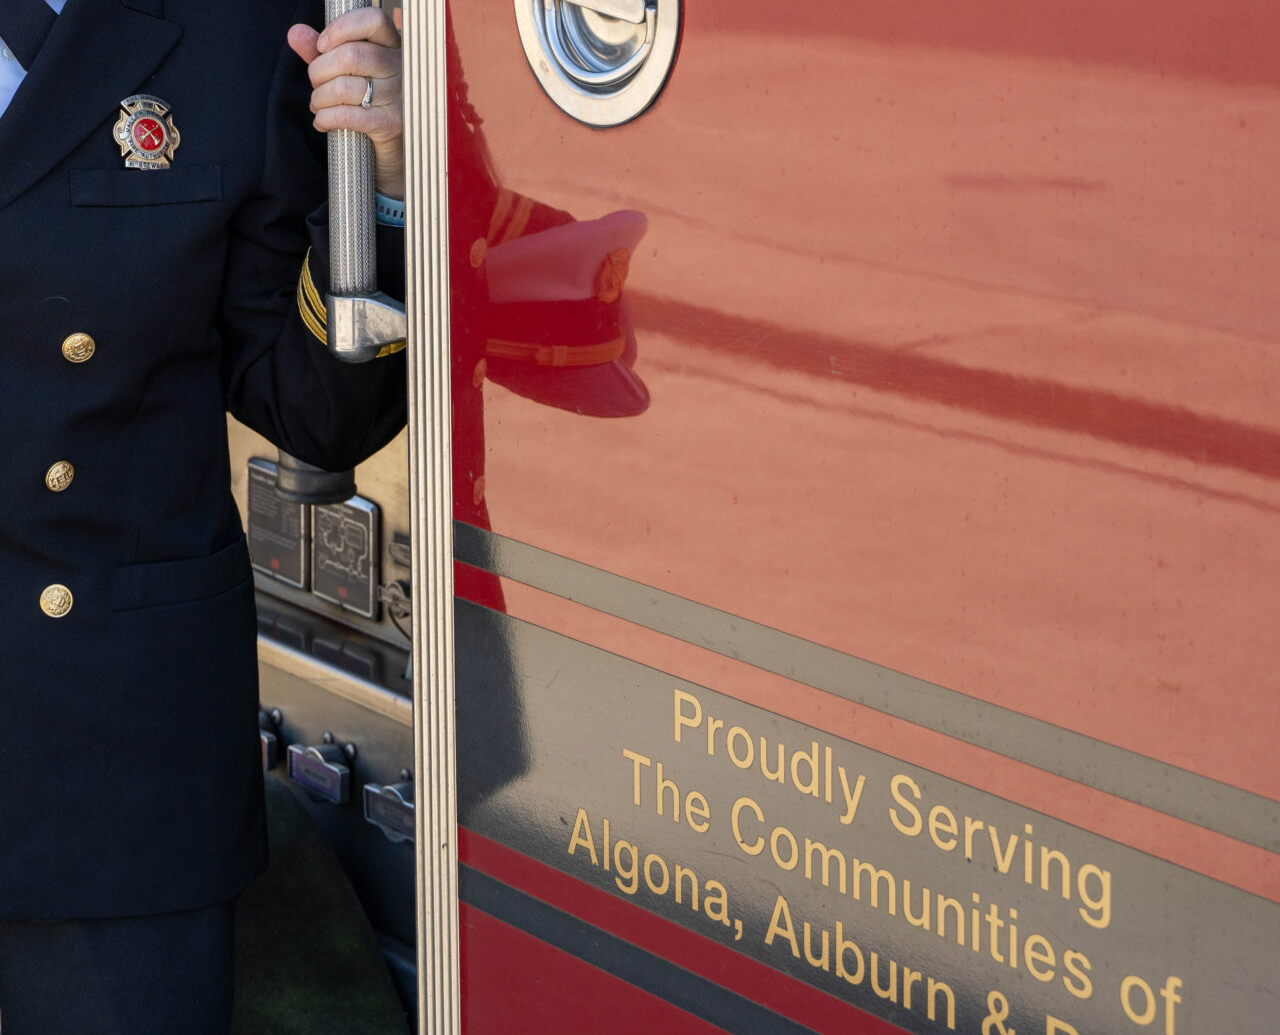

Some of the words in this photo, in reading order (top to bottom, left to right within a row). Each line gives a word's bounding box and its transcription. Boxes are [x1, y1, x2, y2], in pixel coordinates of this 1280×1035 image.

[567, 807, 743, 942] Algona,
[764, 894, 955, 1030] Auburn
[981, 989, 1016, 1035] &
[623, 748, 711, 834] The
[730, 796, 1094, 999] Communities
[1119, 975, 1183, 1035] of
[673, 688, 867, 826] Proudly
[888, 773, 1113, 929] Serving
